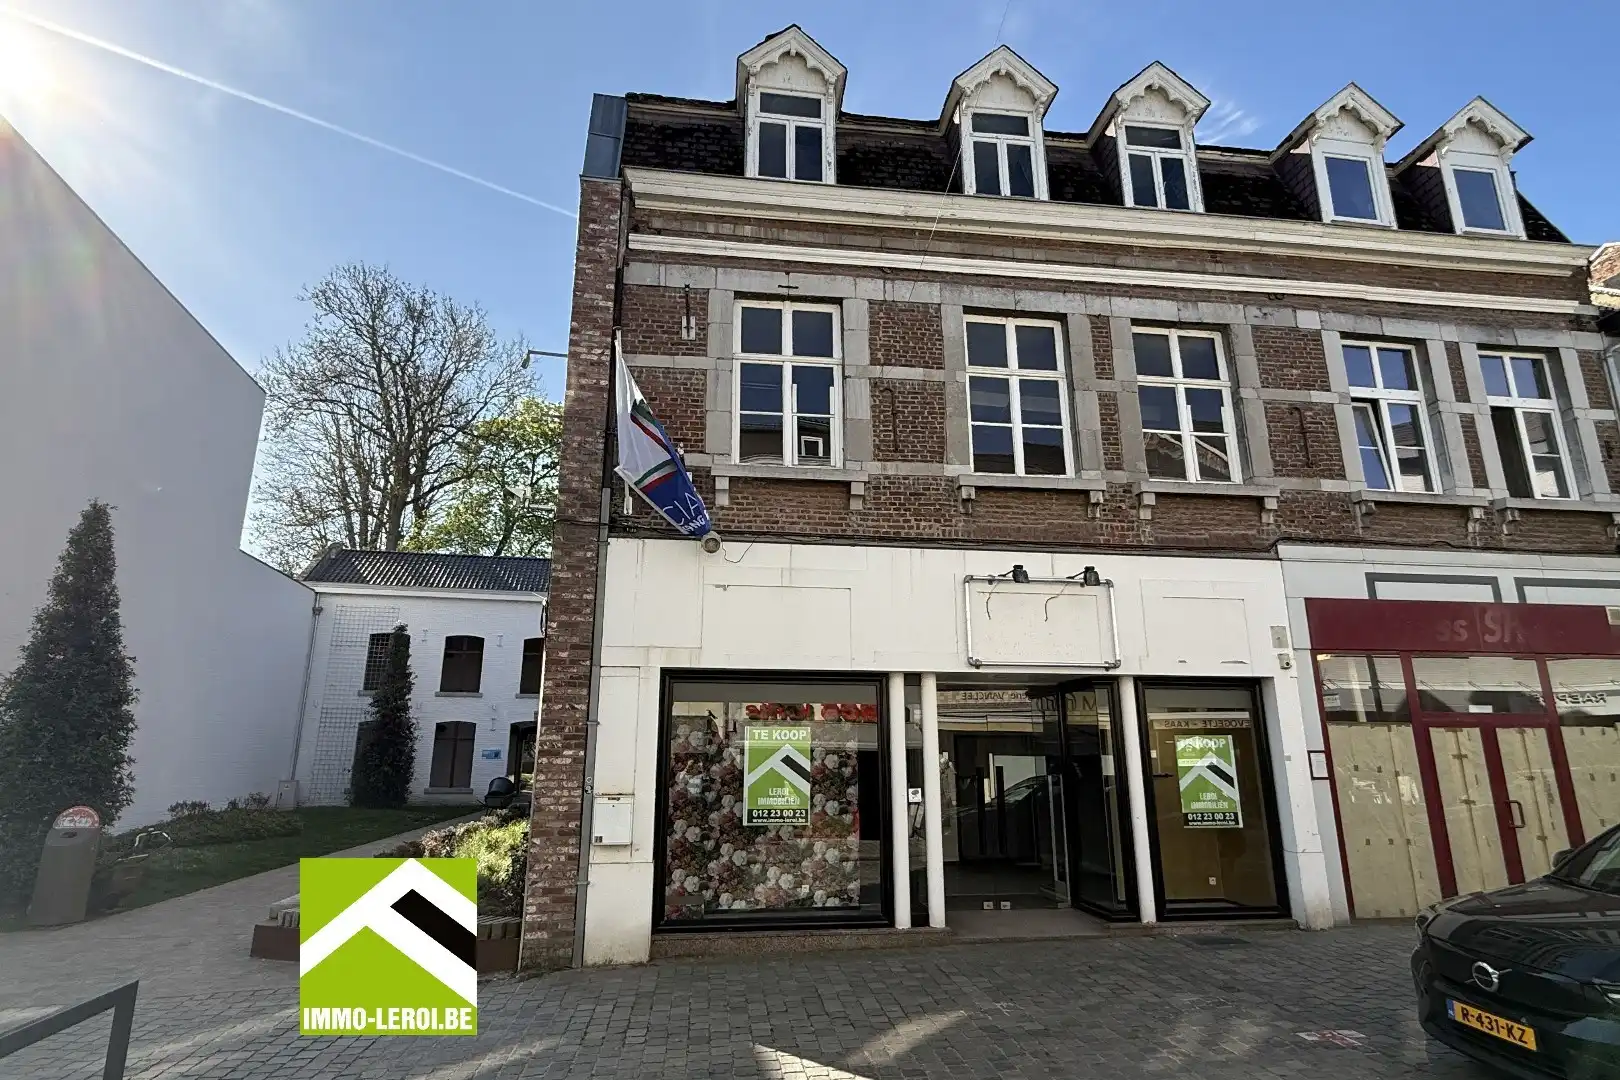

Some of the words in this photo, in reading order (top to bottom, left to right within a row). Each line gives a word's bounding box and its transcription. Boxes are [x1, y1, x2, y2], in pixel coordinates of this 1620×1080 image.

[752, 729, 769, 740] TE
[772, 729, 808, 741] KOOP
[752, 809, 768, 817] 012
[770, 809, 781, 817] 23
[783, 809, 794, 817] 00
[795, 809, 806, 817] 23
[1187, 812, 1202, 820] 012
[1203, 812, 1213, 820] 23
[1214, 812, 1224, 820] 00
[1225, 812, 1235, 820] 23
[1460, 1006, 1528, 1045] R-431-KZ
